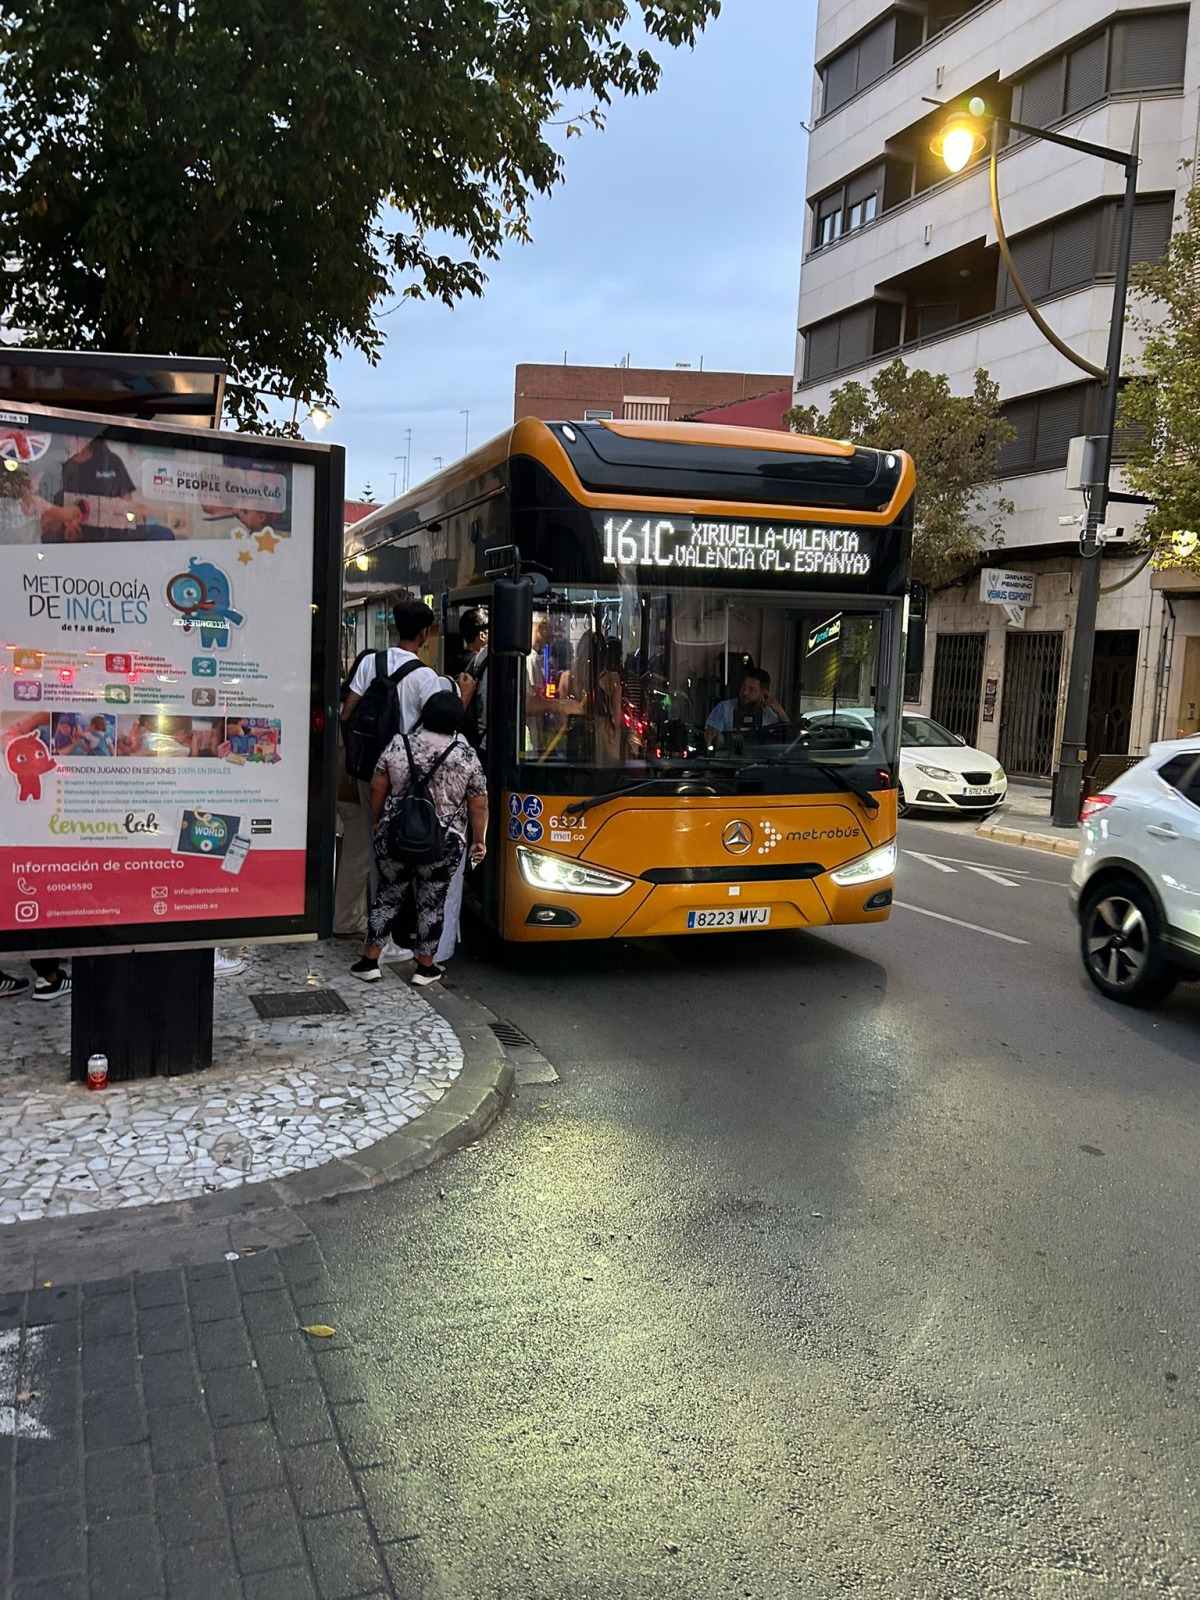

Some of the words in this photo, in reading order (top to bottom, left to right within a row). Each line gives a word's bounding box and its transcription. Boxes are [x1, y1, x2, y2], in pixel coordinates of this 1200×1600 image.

[177, 478, 220, 492] PEOPLE
[226, 480, 261, 496] lemon
[264, 486, 281, 498] lab
[603, 518, 675, 566] 161C
[692, 523, 859, 552] XIRIVELLA-VALENCIA
[760, 549, 790, 570] (PL.
[794, 551, 870, 574] ESPANYA)
[24, 574, 150, 602] METODOLOGÍA
[987, 589, 1007, 599] VENUS
[1008, 591, 1032, 602] ESPORT
[30, 594, 60, 619] DE
[66, 595, 148, 624] INGLÉS
[62, 624, 72, 632] de
[74, 624, 78, 632] 1
[57, 766, 96, 774] APRENDEN
[97, 766, 131, 774] JUGANDO
[177, 767, 196, 775] 100%
[208, 766, 231, 775] INGLÉS
[48, 814, 122, 834] lemon
[123, 813, 160, 834] lab
[550, 816, 587, 829] 6321
[195, 826, 225, 837] WORLD
[786, 826, 860, 841] metrobús
[12, 860, 99, 873] Información
[103, 860, 120, 871] de
[124, 860, 184, 871] contacto
[47, 883, 92, 892] 601045590
[174, 886, 239, 896] info@lemonlab.es
[46, 908, 120, 918] @lemonlabacademy
[174, 903, 218, 911] lemonlab.es
[697, 912, 734, 926] 8223
[739, 909, 767, 924] MVJ
